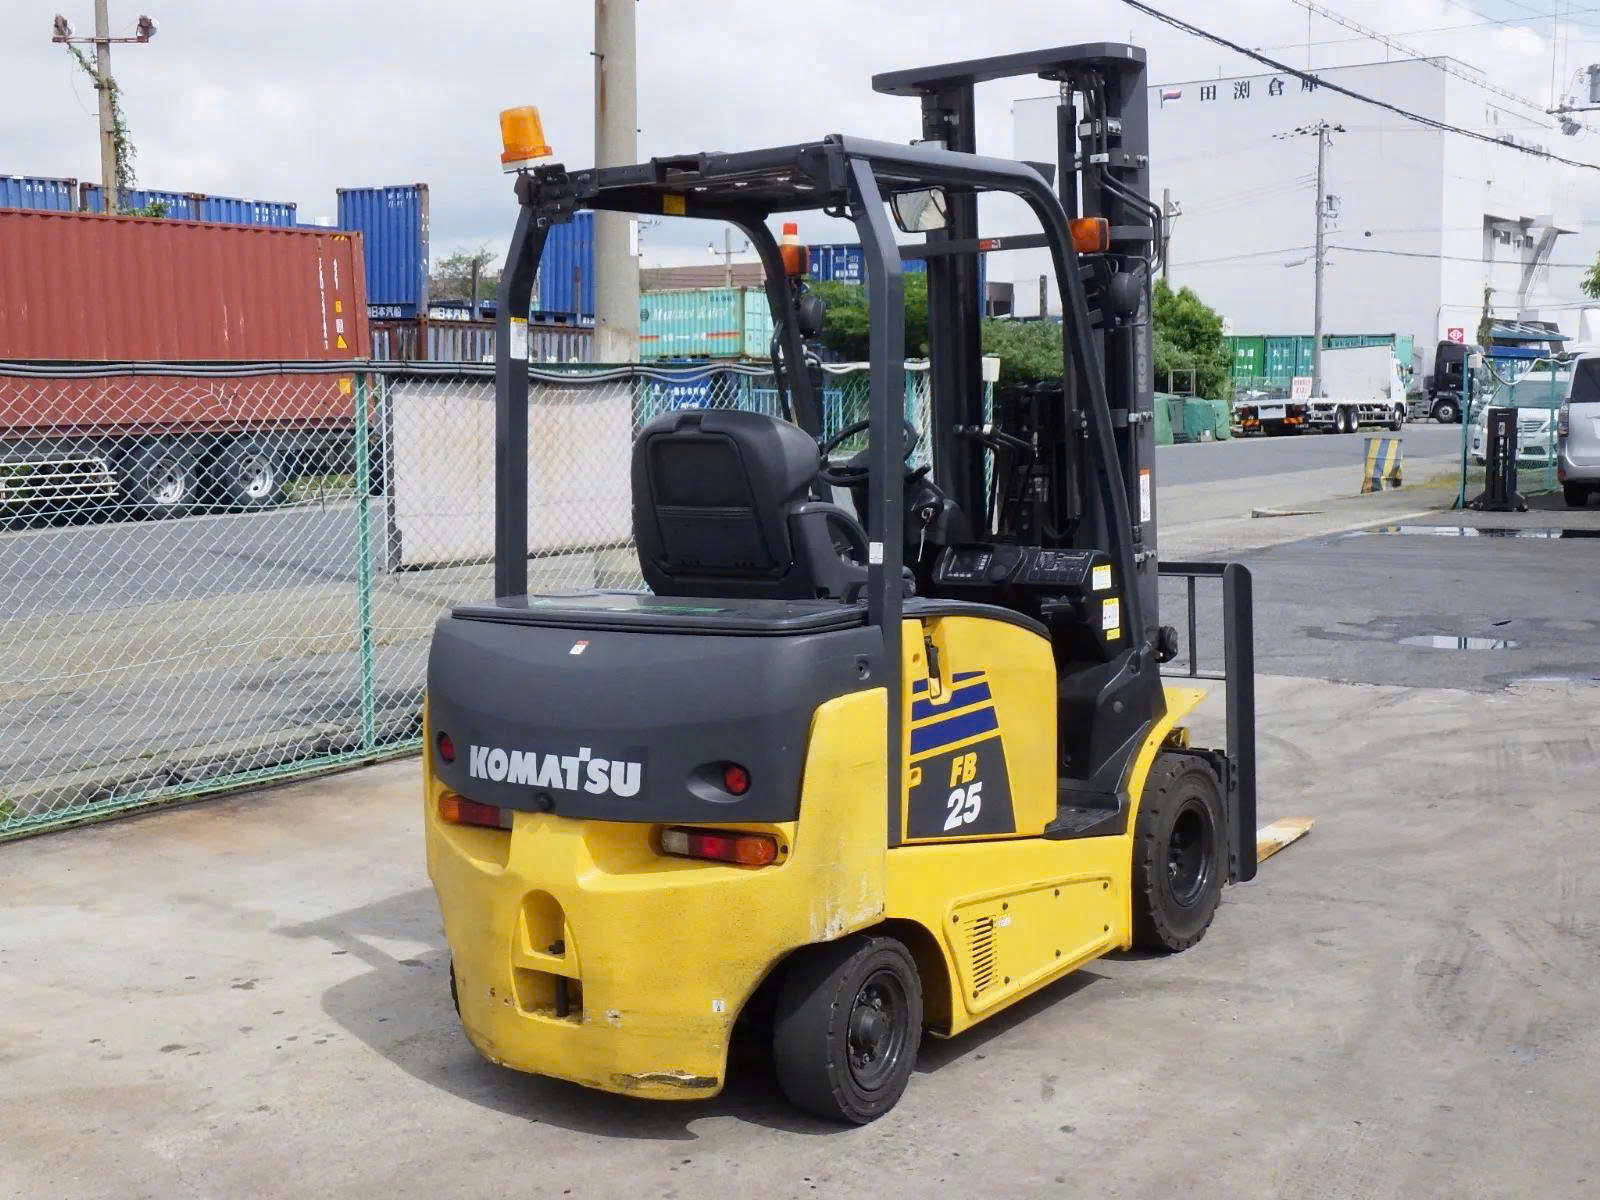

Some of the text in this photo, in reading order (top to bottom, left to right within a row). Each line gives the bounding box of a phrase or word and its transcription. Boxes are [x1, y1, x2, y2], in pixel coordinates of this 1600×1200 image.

[469, 745, 641, 797] KOMATSU
[949, 752, 978, 788] FB
[943, 782, 982, 831] 25
